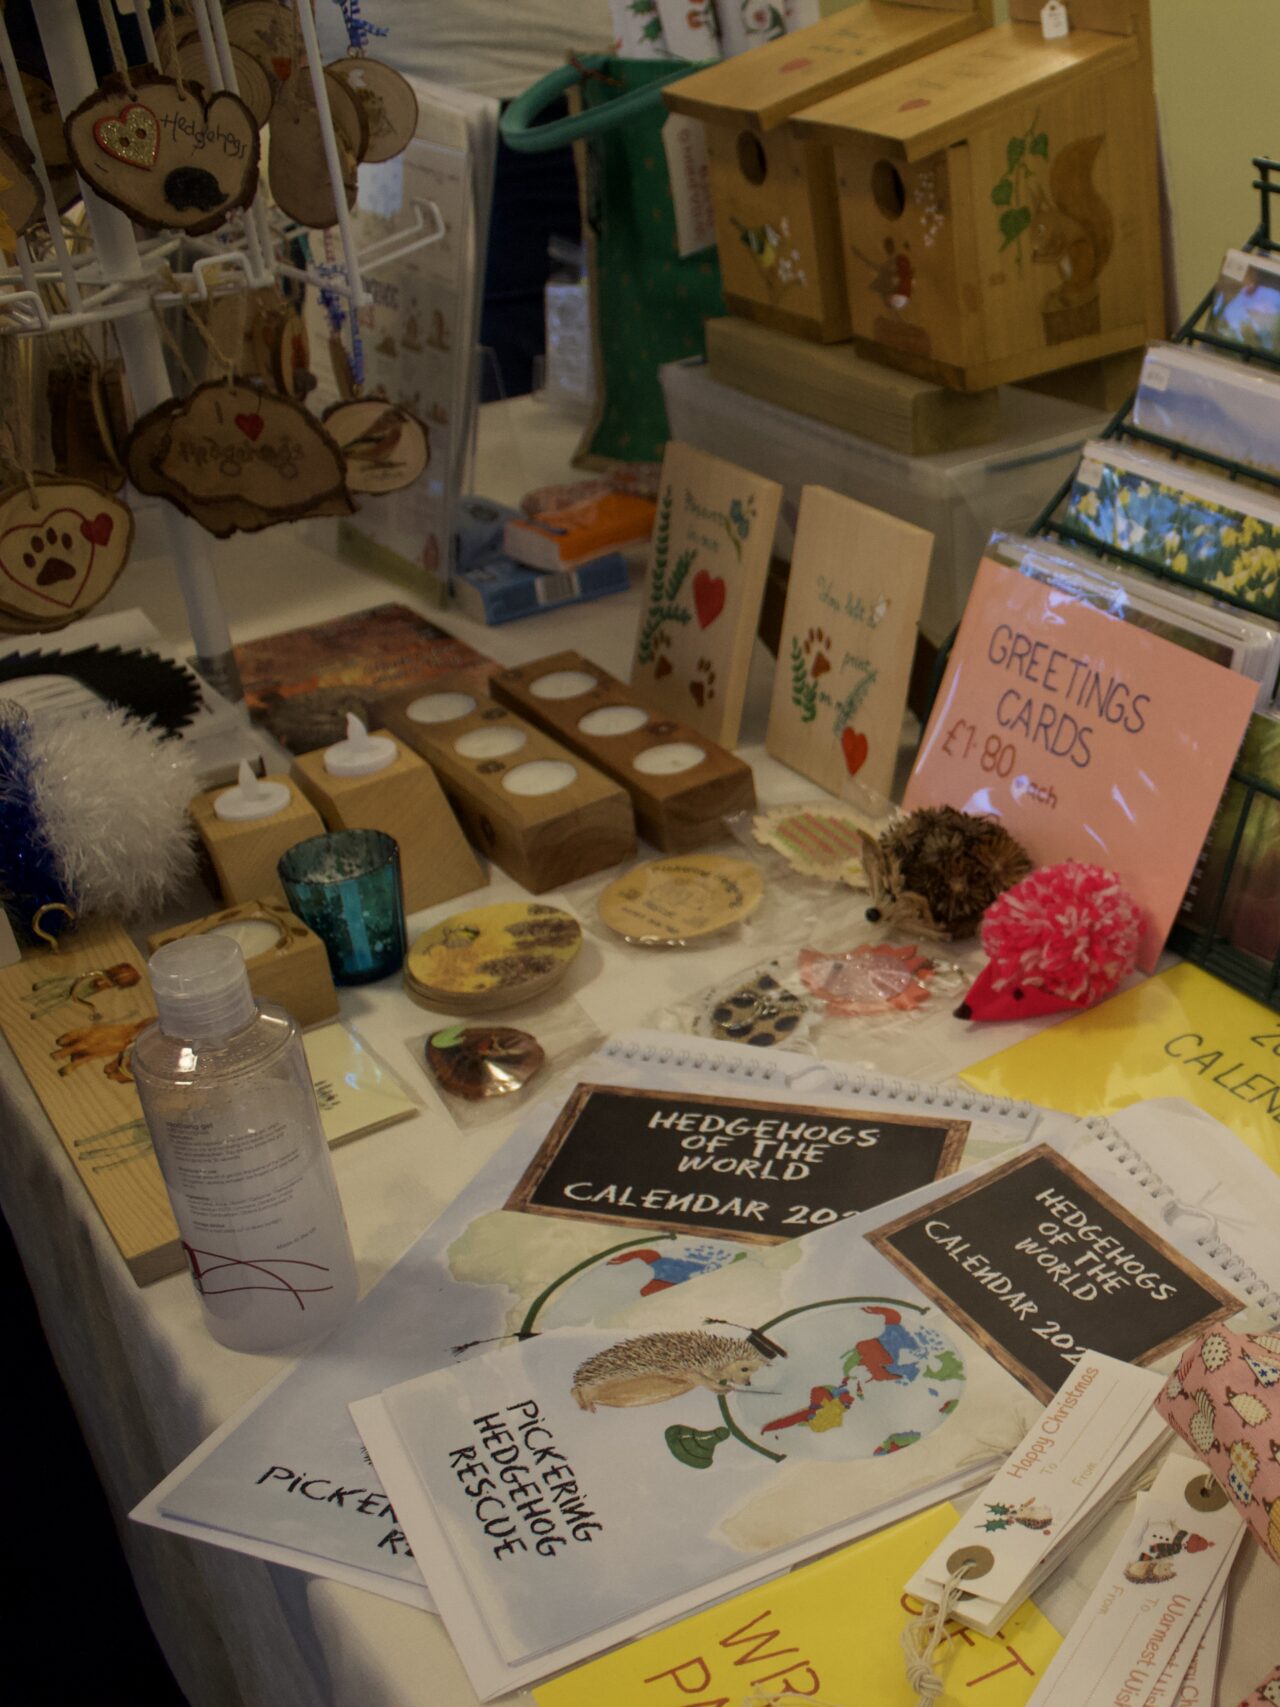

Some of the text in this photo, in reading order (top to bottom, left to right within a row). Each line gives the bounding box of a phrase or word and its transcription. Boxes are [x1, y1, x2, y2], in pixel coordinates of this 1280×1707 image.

[987, 623, 1151, 734] GREETINGS
[996, 688, 1094, 768] CARDS
[648, 1110, 881, 1148] HEDGEHOGS
[680, 1134, 831, 1163] OF THE
[562, 1181, 770, 1222] CALENDAR
[677, 1155, 811, 1181] WORLD
[924, 1220, 1039, 1321] CALENDAR
[1013, 1236, 1099, 1302] WORLD
[1034, 1187, 1178, 1301] HEDGEHOGS
[1037, 1221, 1132, 1295] OF THE
[1007, 1366, 1100, 1479] Happy Christmas
[448, 1445, 528, 1561] RESCUE
[473, 1411, 568, 1558] HEDGEHOG
[1136, 1594, 1192, 1667] Warmest
